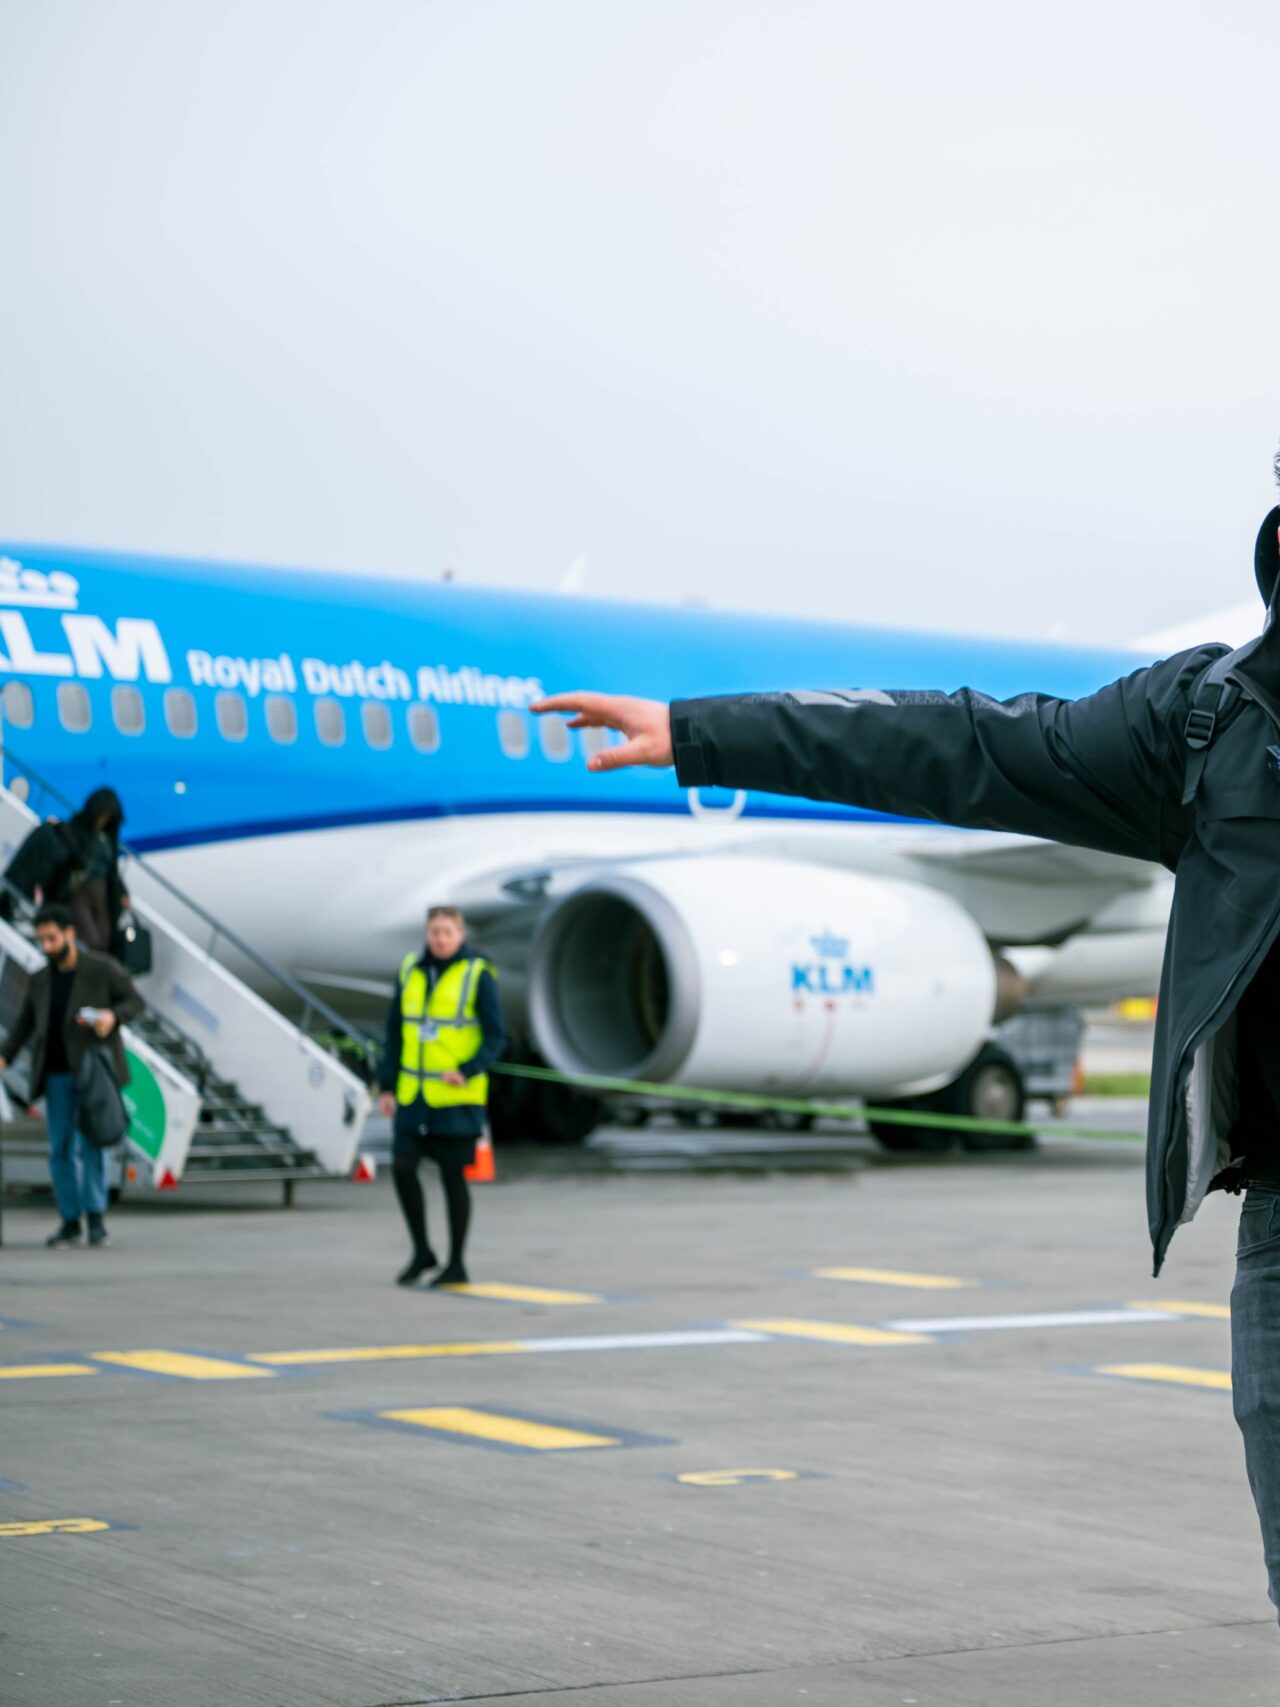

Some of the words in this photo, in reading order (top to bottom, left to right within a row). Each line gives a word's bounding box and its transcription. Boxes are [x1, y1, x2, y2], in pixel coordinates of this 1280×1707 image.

[0, 609, 172, 684] LM
[187, 649, 297, 698] Royal
[302, 657, 412, 701] Dutch
[417, 664, 546, 709] Airlines
[790, 963, 874, 995] KLM
